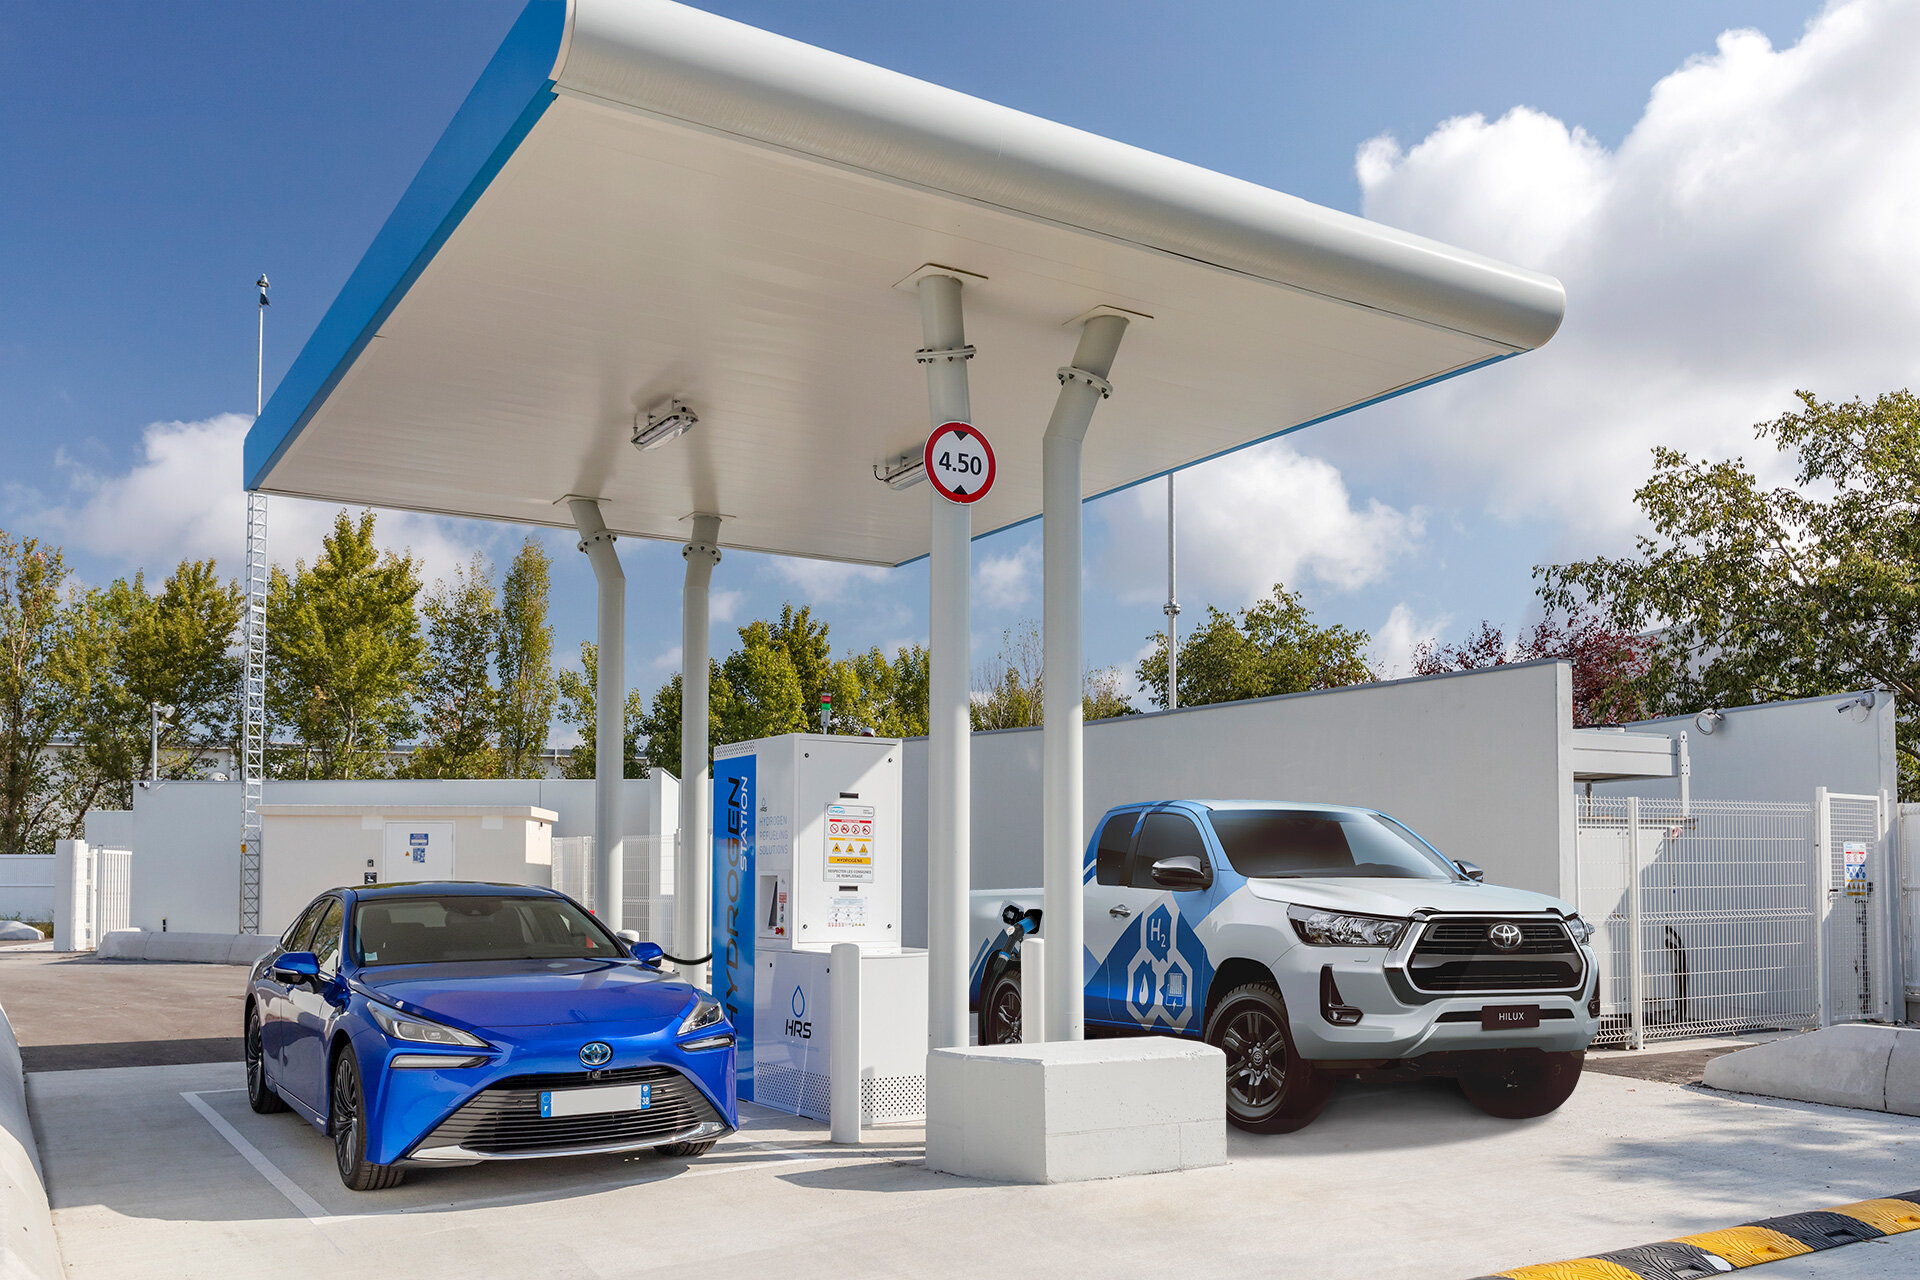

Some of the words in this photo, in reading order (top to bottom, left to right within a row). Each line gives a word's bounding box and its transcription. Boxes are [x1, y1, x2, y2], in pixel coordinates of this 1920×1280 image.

[938, 451, 982, 475] 4.50
[740, 776, 748, 872] STATION
[759, 815, 788, 826] HYDROGEN
[759, 830, 789, 841] REFUELING
[759, 844, 789, 856] SOLUTIONS
[1498, 1012, 1525, 1021] HILUX
[785, 1018, 812, 1040] HRS
[641, 1097, 650, 1105] 38
